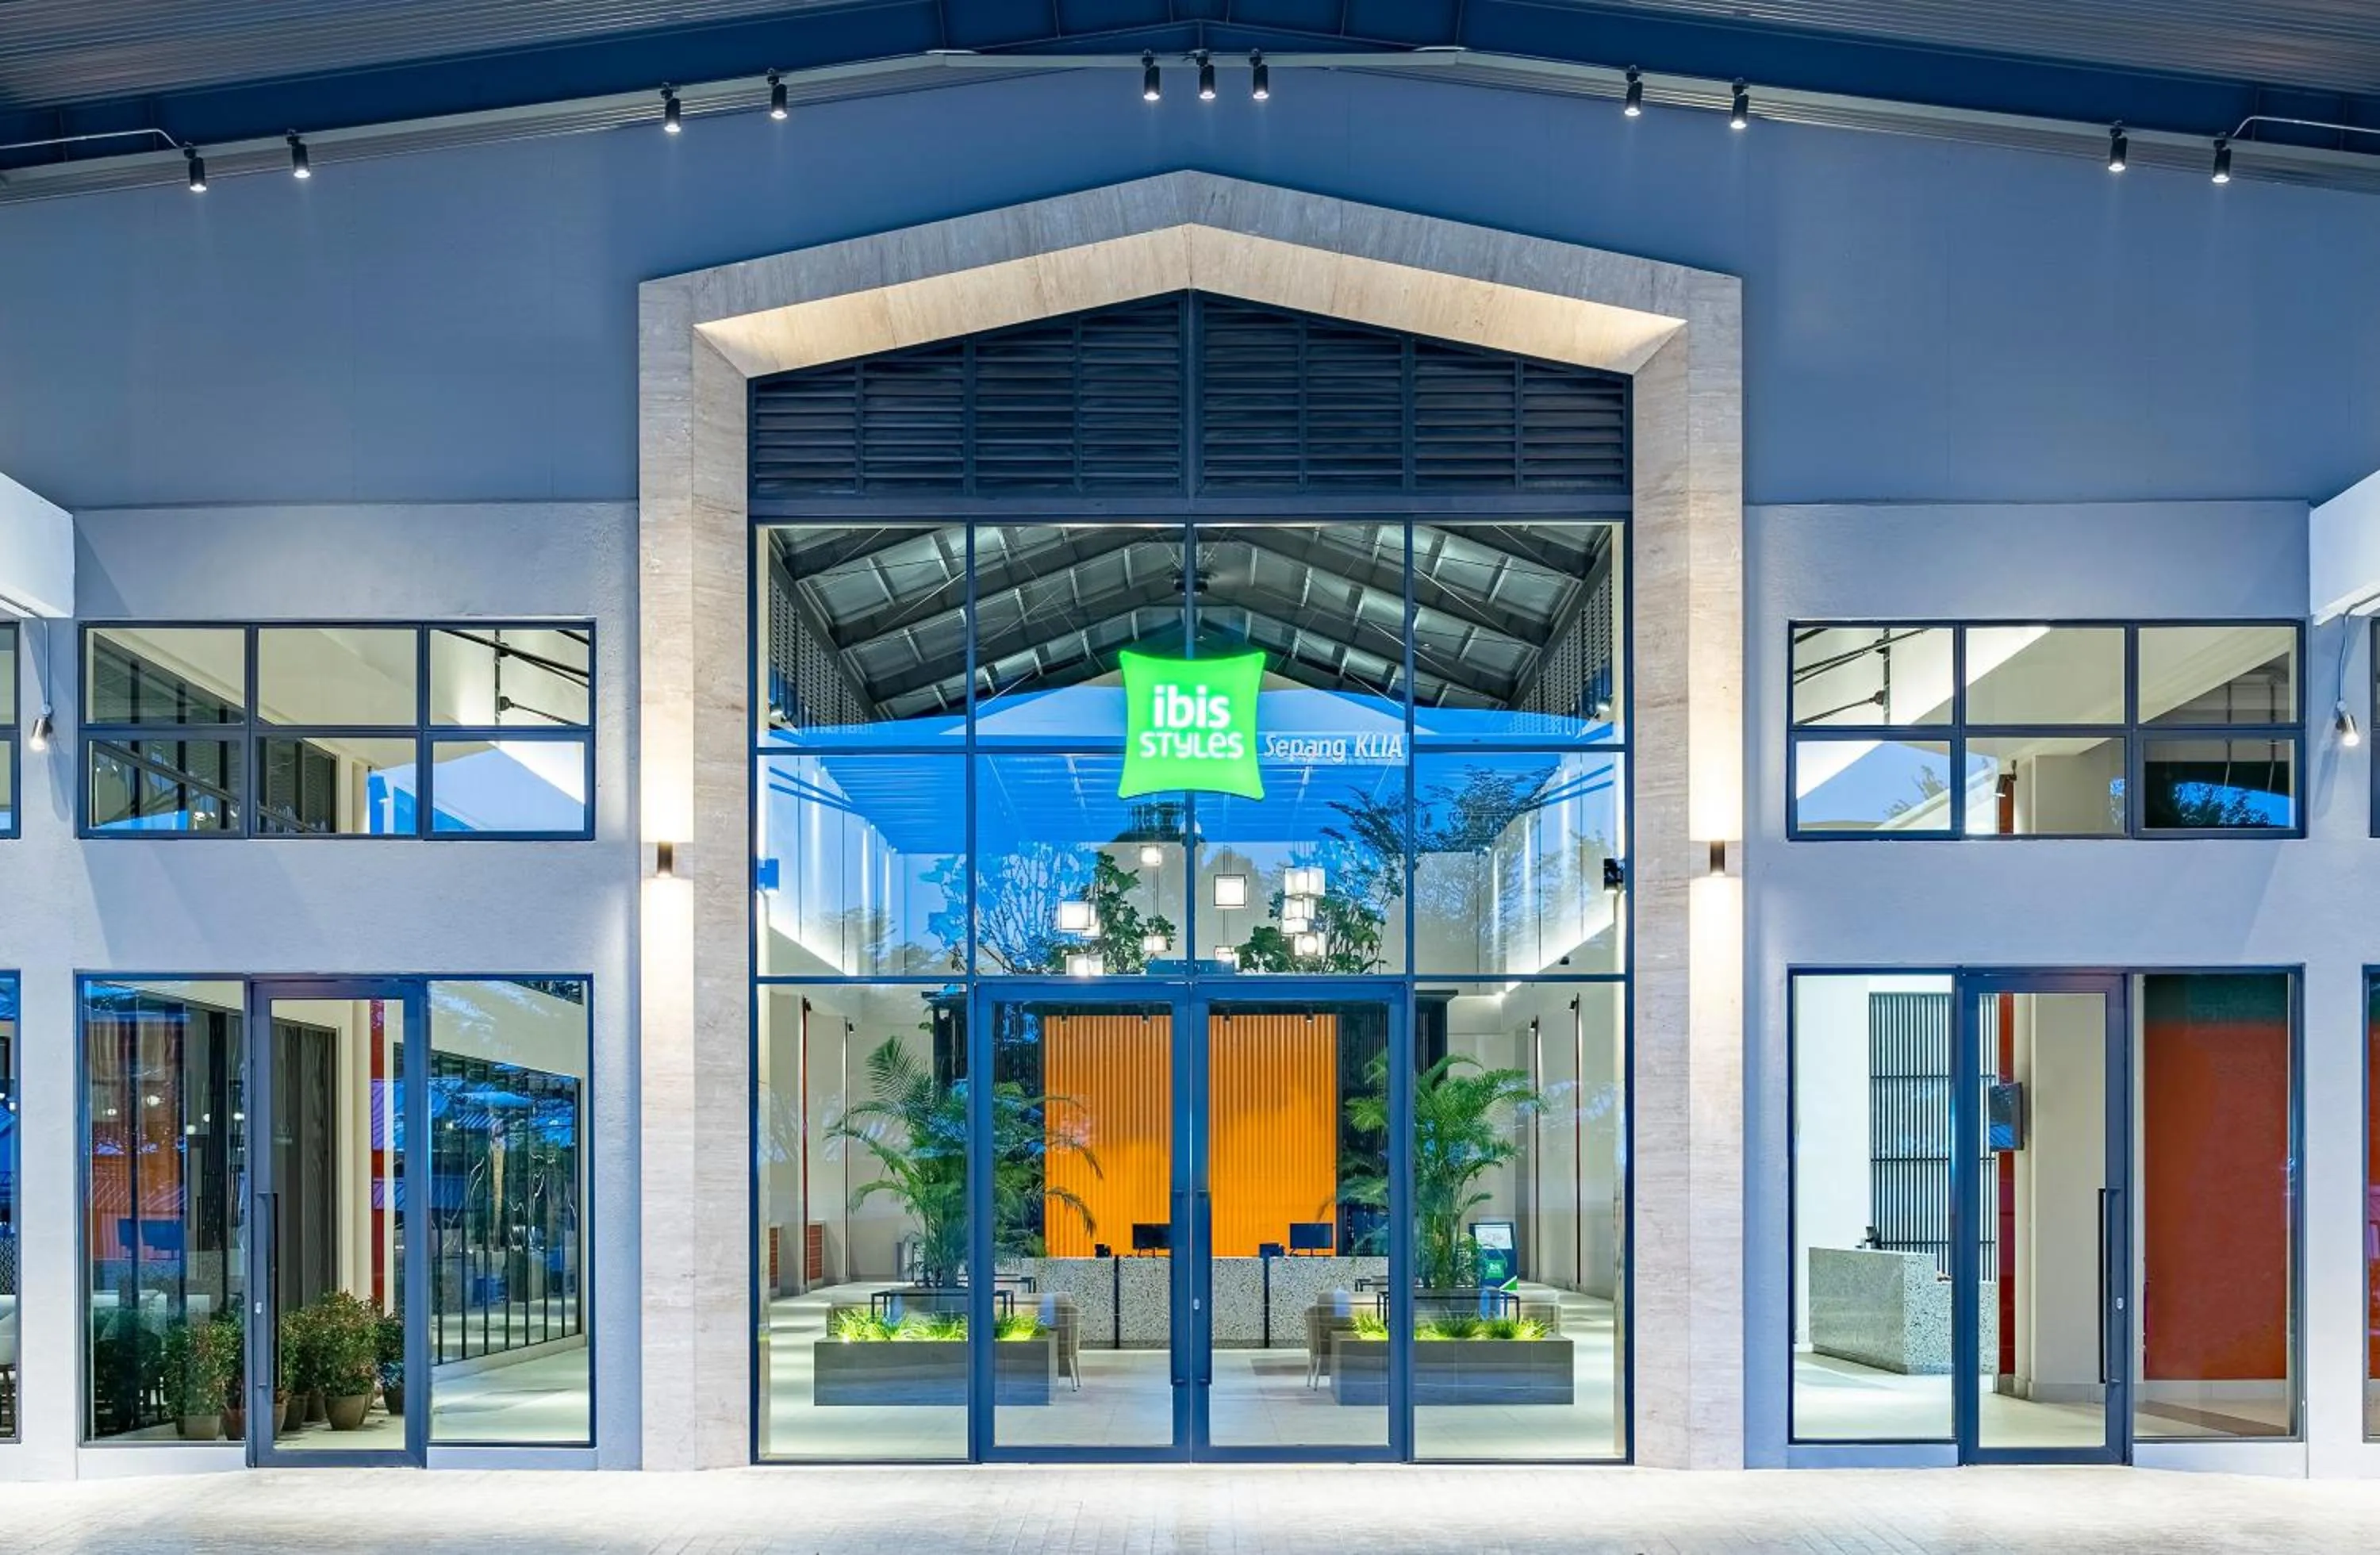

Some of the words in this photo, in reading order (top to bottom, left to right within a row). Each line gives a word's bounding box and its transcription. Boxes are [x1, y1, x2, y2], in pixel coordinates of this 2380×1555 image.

[1154, 684, 1231, 728] ibis
[1264, 733, 1346, 763] Sepang
[1354, 733, 1403, 759] KLIA
